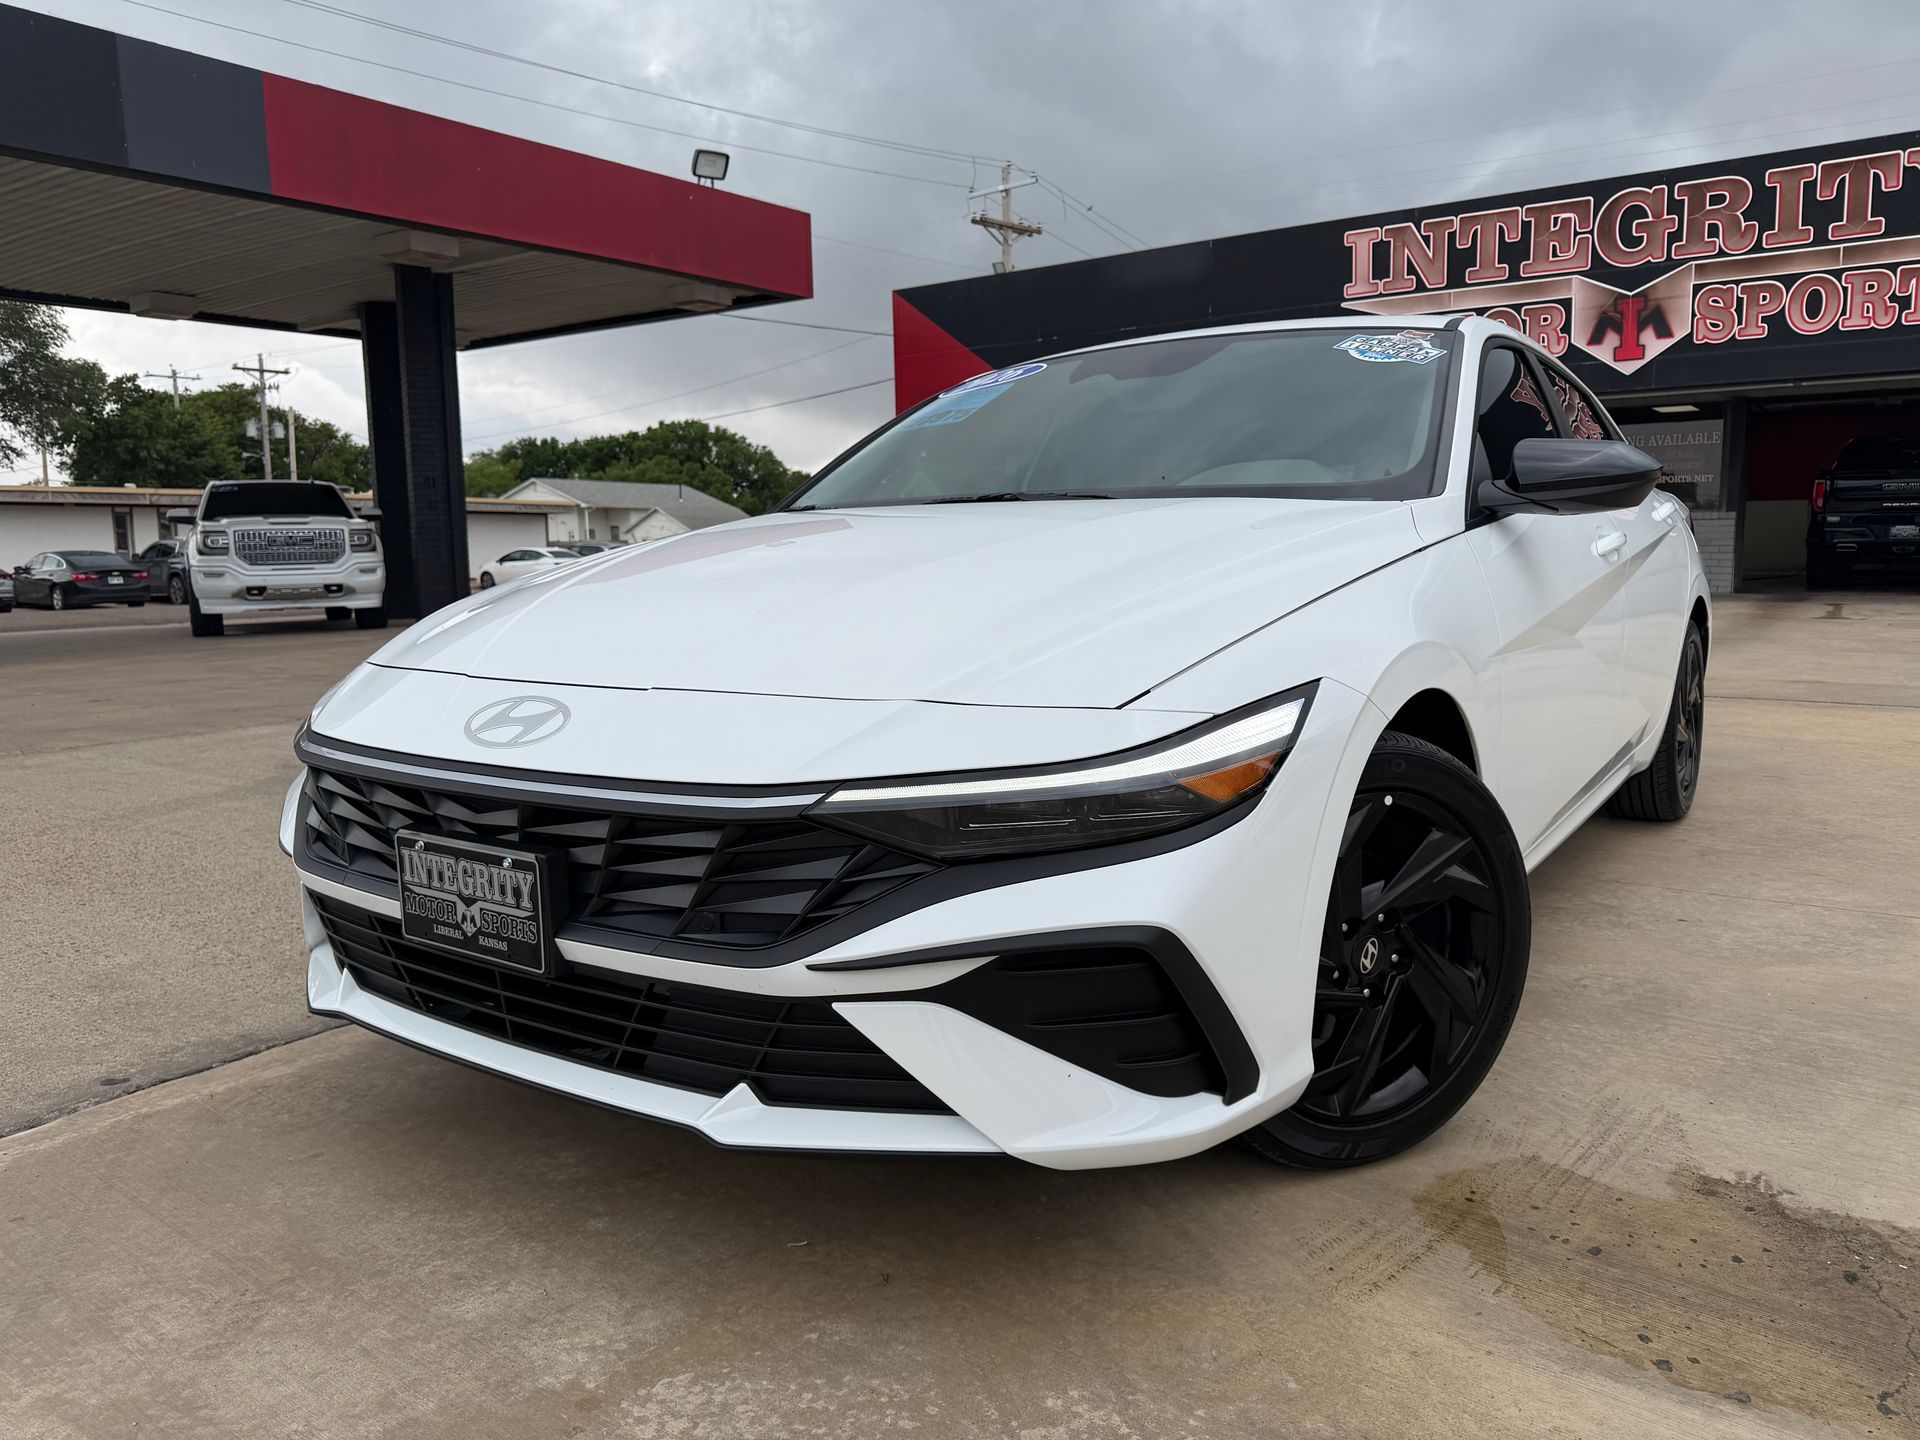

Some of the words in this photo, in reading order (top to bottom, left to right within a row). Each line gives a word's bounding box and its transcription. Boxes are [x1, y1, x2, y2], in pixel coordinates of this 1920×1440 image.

[1343, 147, 1920, 299] INTEGRIT
[1354, 337, 1434, 356] CARFAX
[1357, 344, 1426, 361] OWNER
[1649, 431, 1721, 447] AVAILABLE
[400, 846, 535, 911] INTEGRITY
[405, 892, 457, 924] MOTOR
[433, 923, 464, 940] LIBERAL
[480, 910, 538, 944] SPORTS
[479, 935, 508, 951] KANSAS
